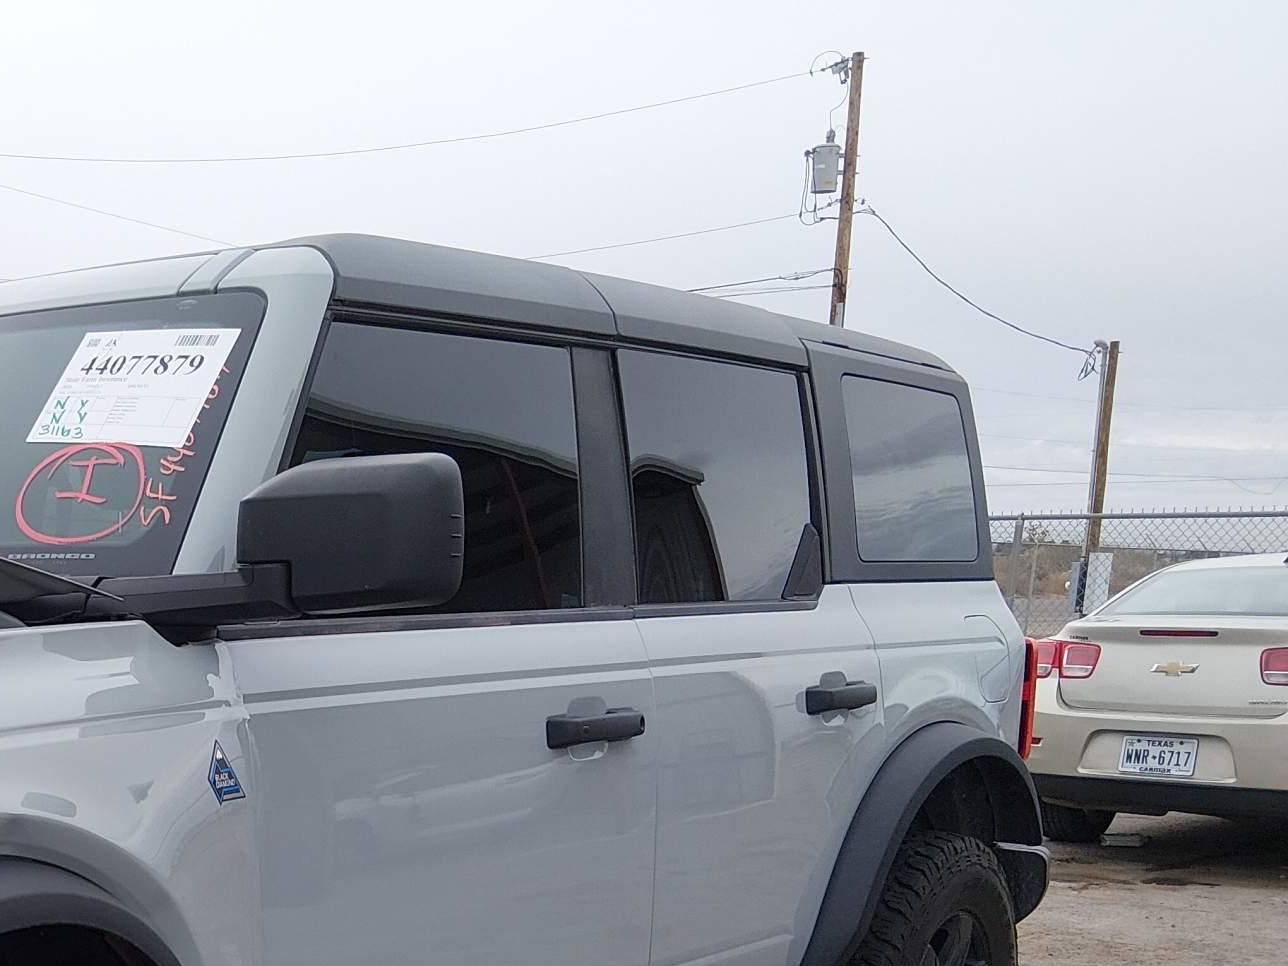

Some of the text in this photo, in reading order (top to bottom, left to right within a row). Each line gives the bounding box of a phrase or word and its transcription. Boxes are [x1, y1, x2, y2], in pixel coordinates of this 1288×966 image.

[80, 354, 205, 376] 44077879
[54, 396, 71, 410] N
[50, 409, 66, 425] N
[139, 477, 177, 526] SF
[1146, 739, 1175, 748] TEXAS
